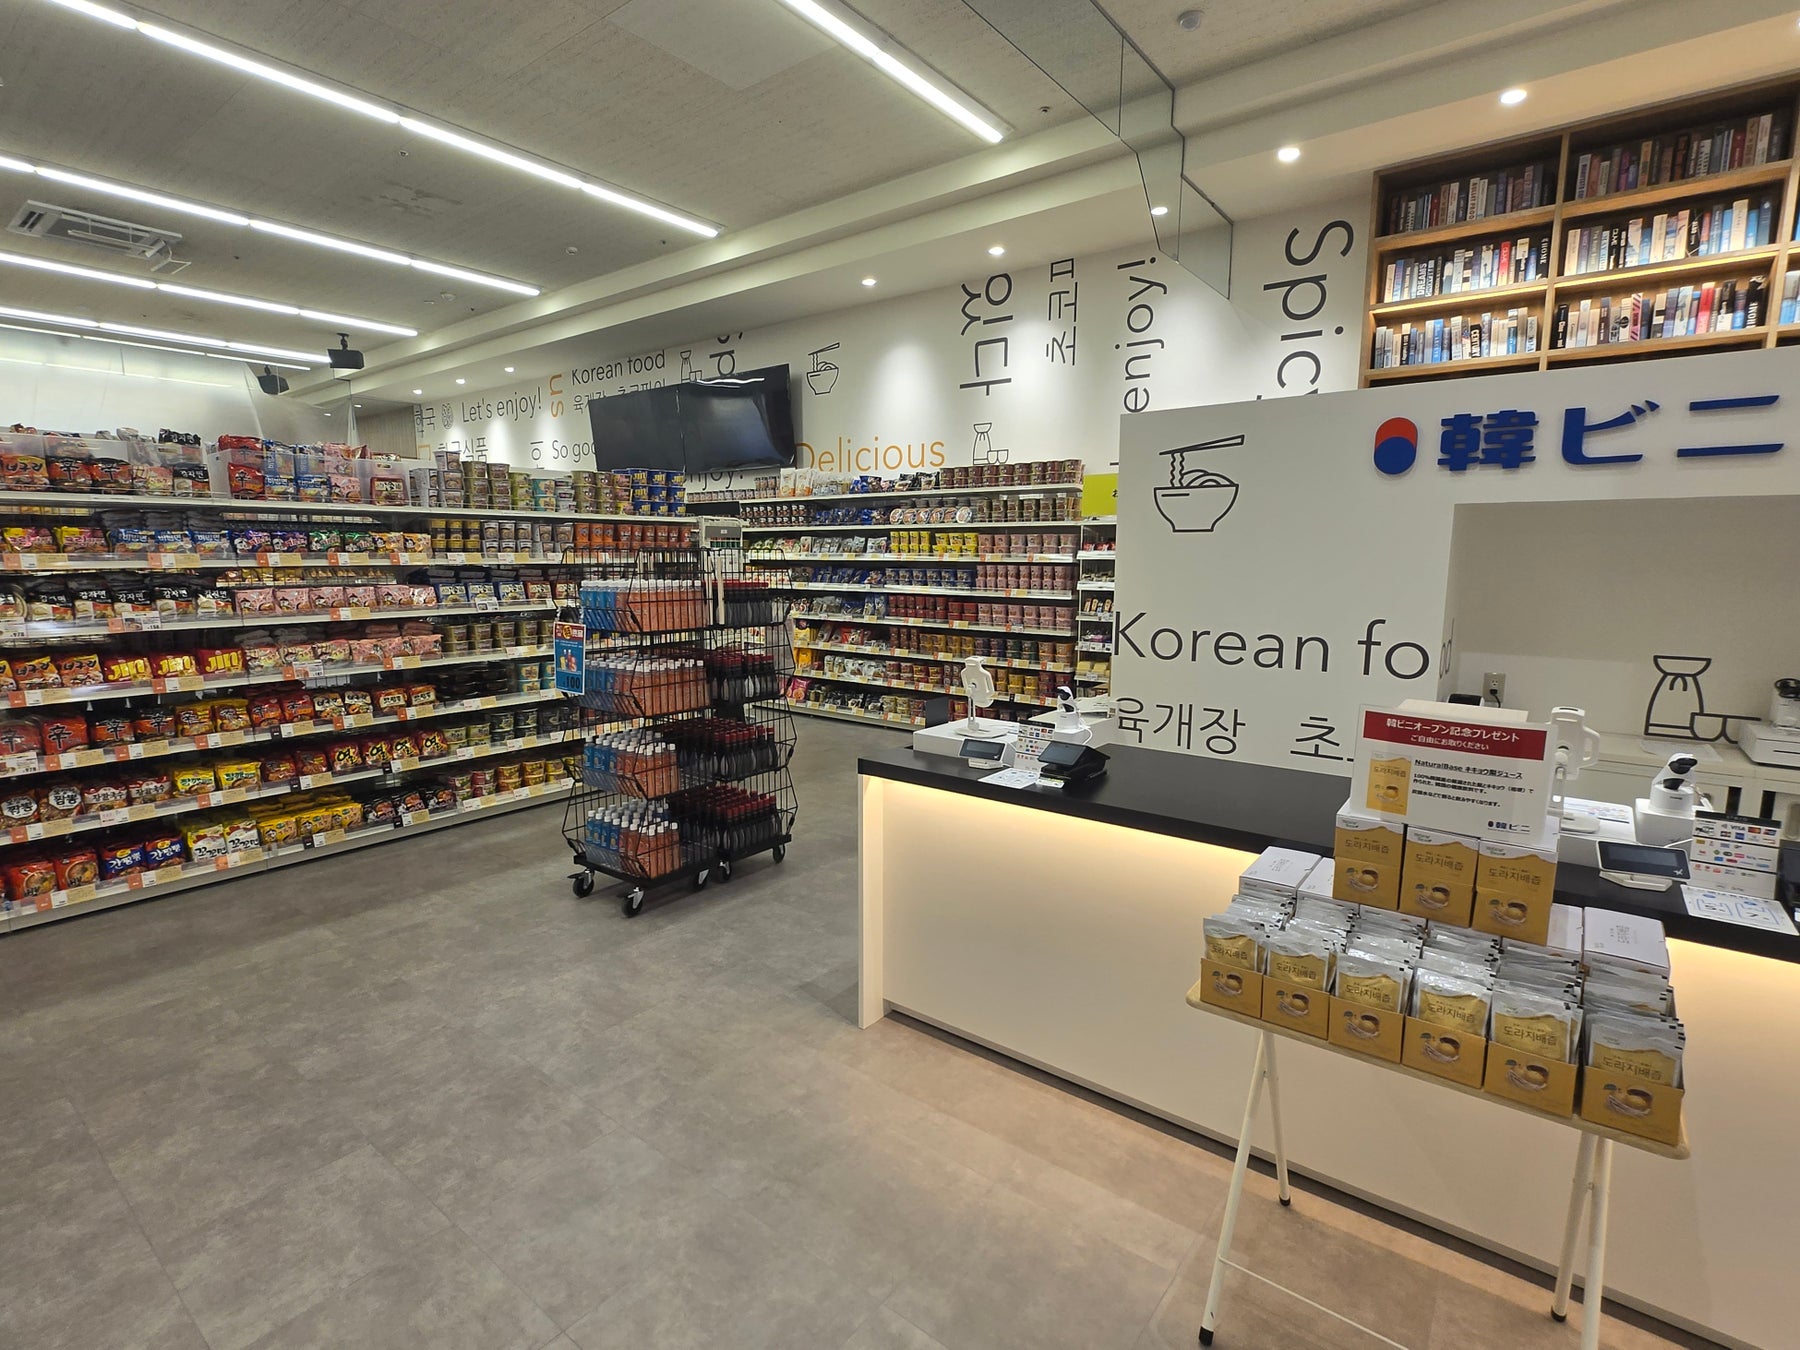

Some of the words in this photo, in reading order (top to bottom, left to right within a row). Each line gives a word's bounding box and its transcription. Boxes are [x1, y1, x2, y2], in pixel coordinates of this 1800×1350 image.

[1256, 220, 1354, 400] Spic
[1117, 256, 1168, 413] enjoy!
[572, 361, 624, 386] Korean
[627, 350, 666, 377] food
[462, 398, 493, 423] Let's
[496, 387, 541, 422] enjoy!
[552, 440, 569, 460] So
[1437, 394, 1785, 472] 韓ビニ
[795, 436, 945, 473] Delicious
[1113, 611, 1330, 674] Korean
[48, 722, 73, 751] 辛
[1115, 697, 1246, 755] 육개장
[1290, 716, 1354, 763] 초
[1385, 717, 1520, 744] 韓ビニオープン記念プレゼント
[1410, 734, 1490, 751] ご自由にお取りください
